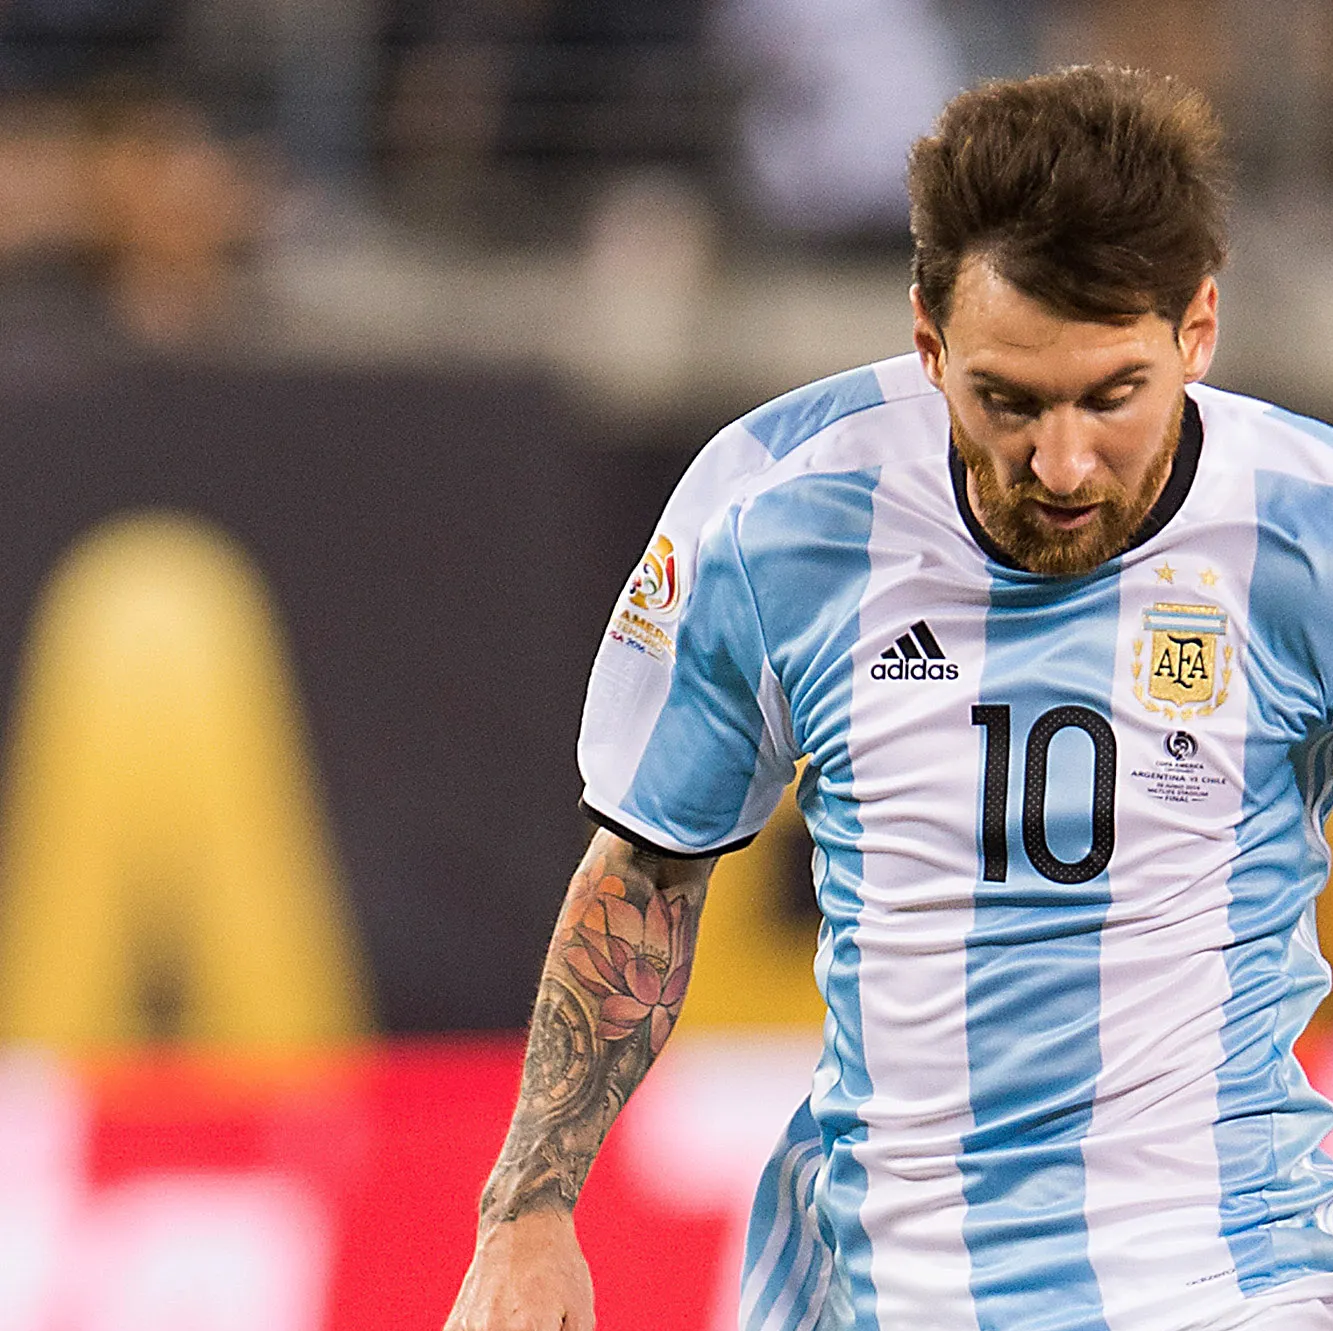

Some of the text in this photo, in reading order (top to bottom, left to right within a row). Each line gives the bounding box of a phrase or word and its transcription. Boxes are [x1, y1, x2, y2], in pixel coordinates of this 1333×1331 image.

[870, 658, 959, 681] adidas
[1154, 633, 1209, 689] AFA
[971, 703, 1118, 886] 10
[1131, 770, 1185, 782] ARGENTINA
